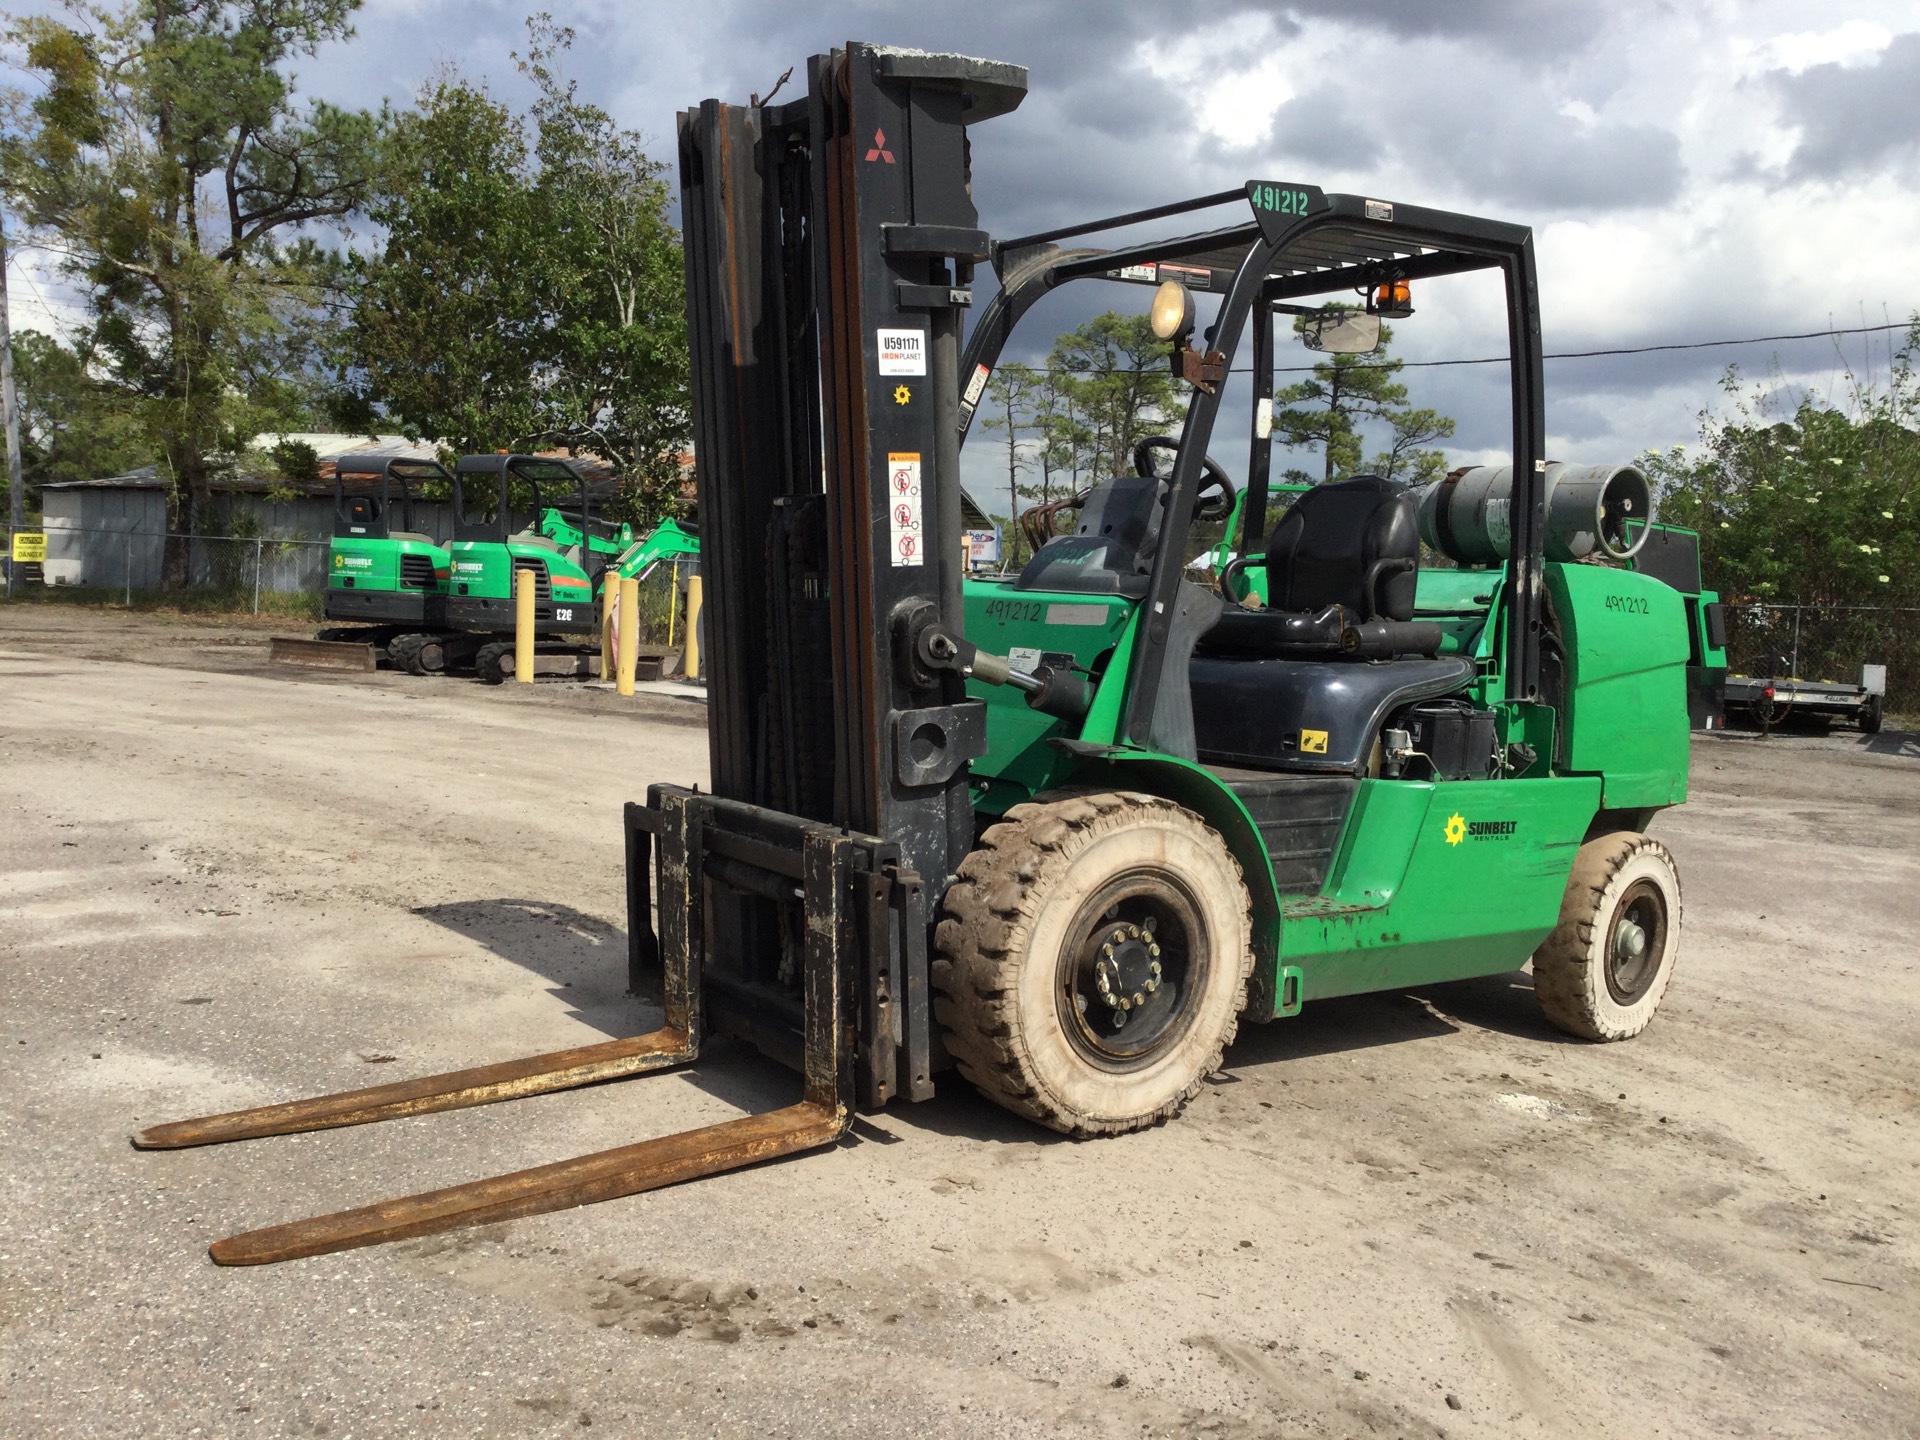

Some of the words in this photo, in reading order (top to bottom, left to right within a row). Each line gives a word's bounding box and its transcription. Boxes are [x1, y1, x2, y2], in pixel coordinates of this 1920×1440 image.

[1252, 184, 1309, 217] 491212
[884, 336, 919, 350] U591171
[881, 352, 921, 360] IRONPLANET
[985, 600, 1041, 622] 491212
[1605, 596, 1650, 615] 491212
[1468, 821, 1518, 836] SUNBELT
